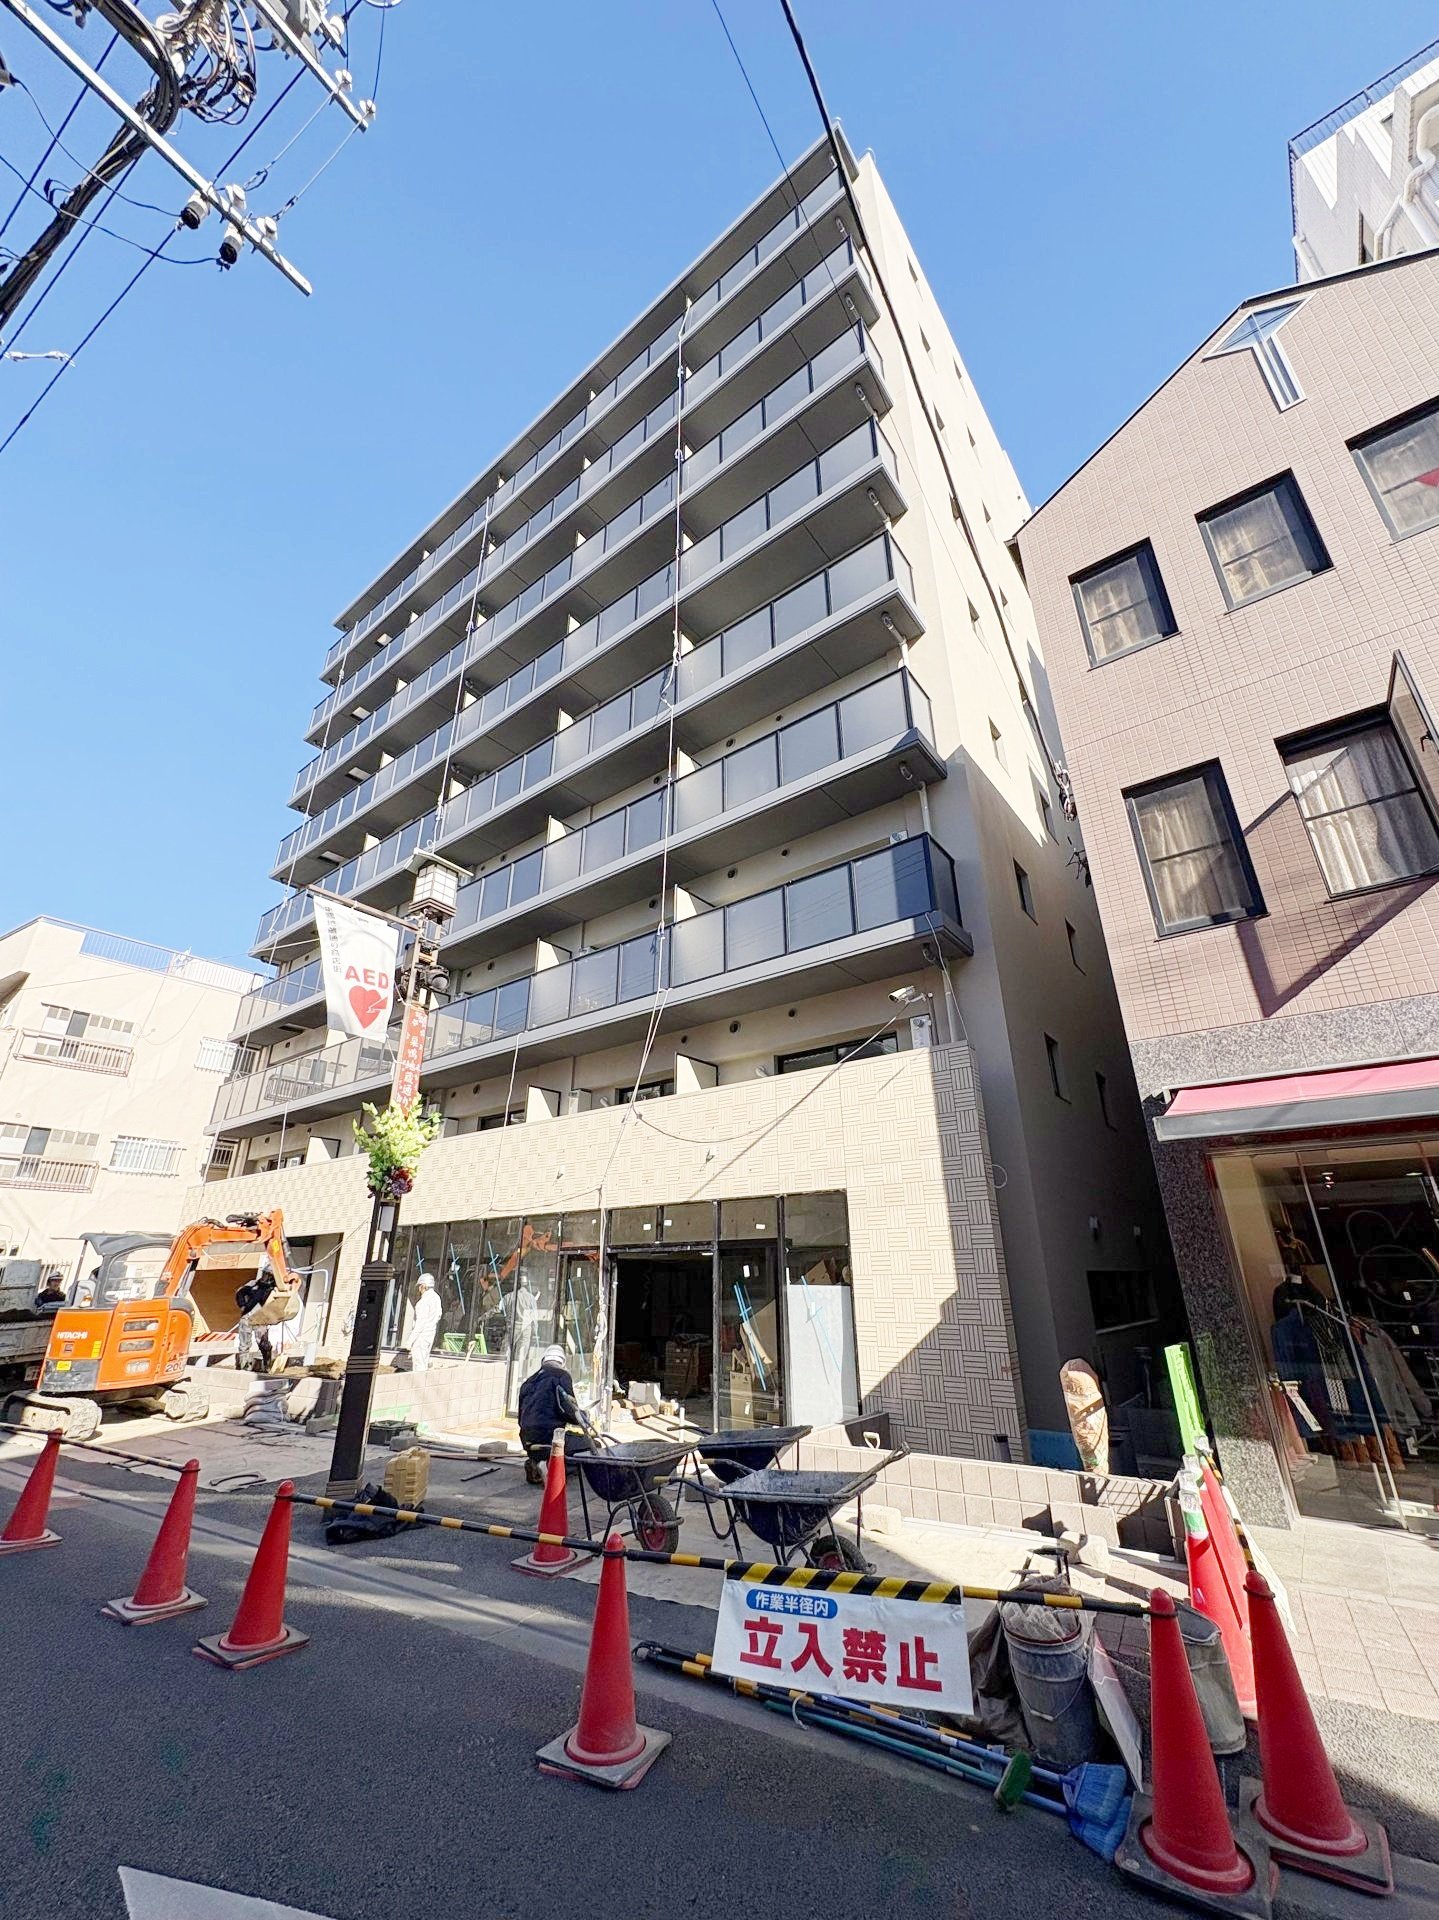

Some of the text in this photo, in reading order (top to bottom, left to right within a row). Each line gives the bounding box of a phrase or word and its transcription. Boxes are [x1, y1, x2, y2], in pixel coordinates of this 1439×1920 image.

[344, 965, 389, 990] AED
[56, 1331, 88, 1339] HITACHI
[755, 1591, 829, 1617] 作業半径内
[740, 1616, 943, 1692] 立入禁止
